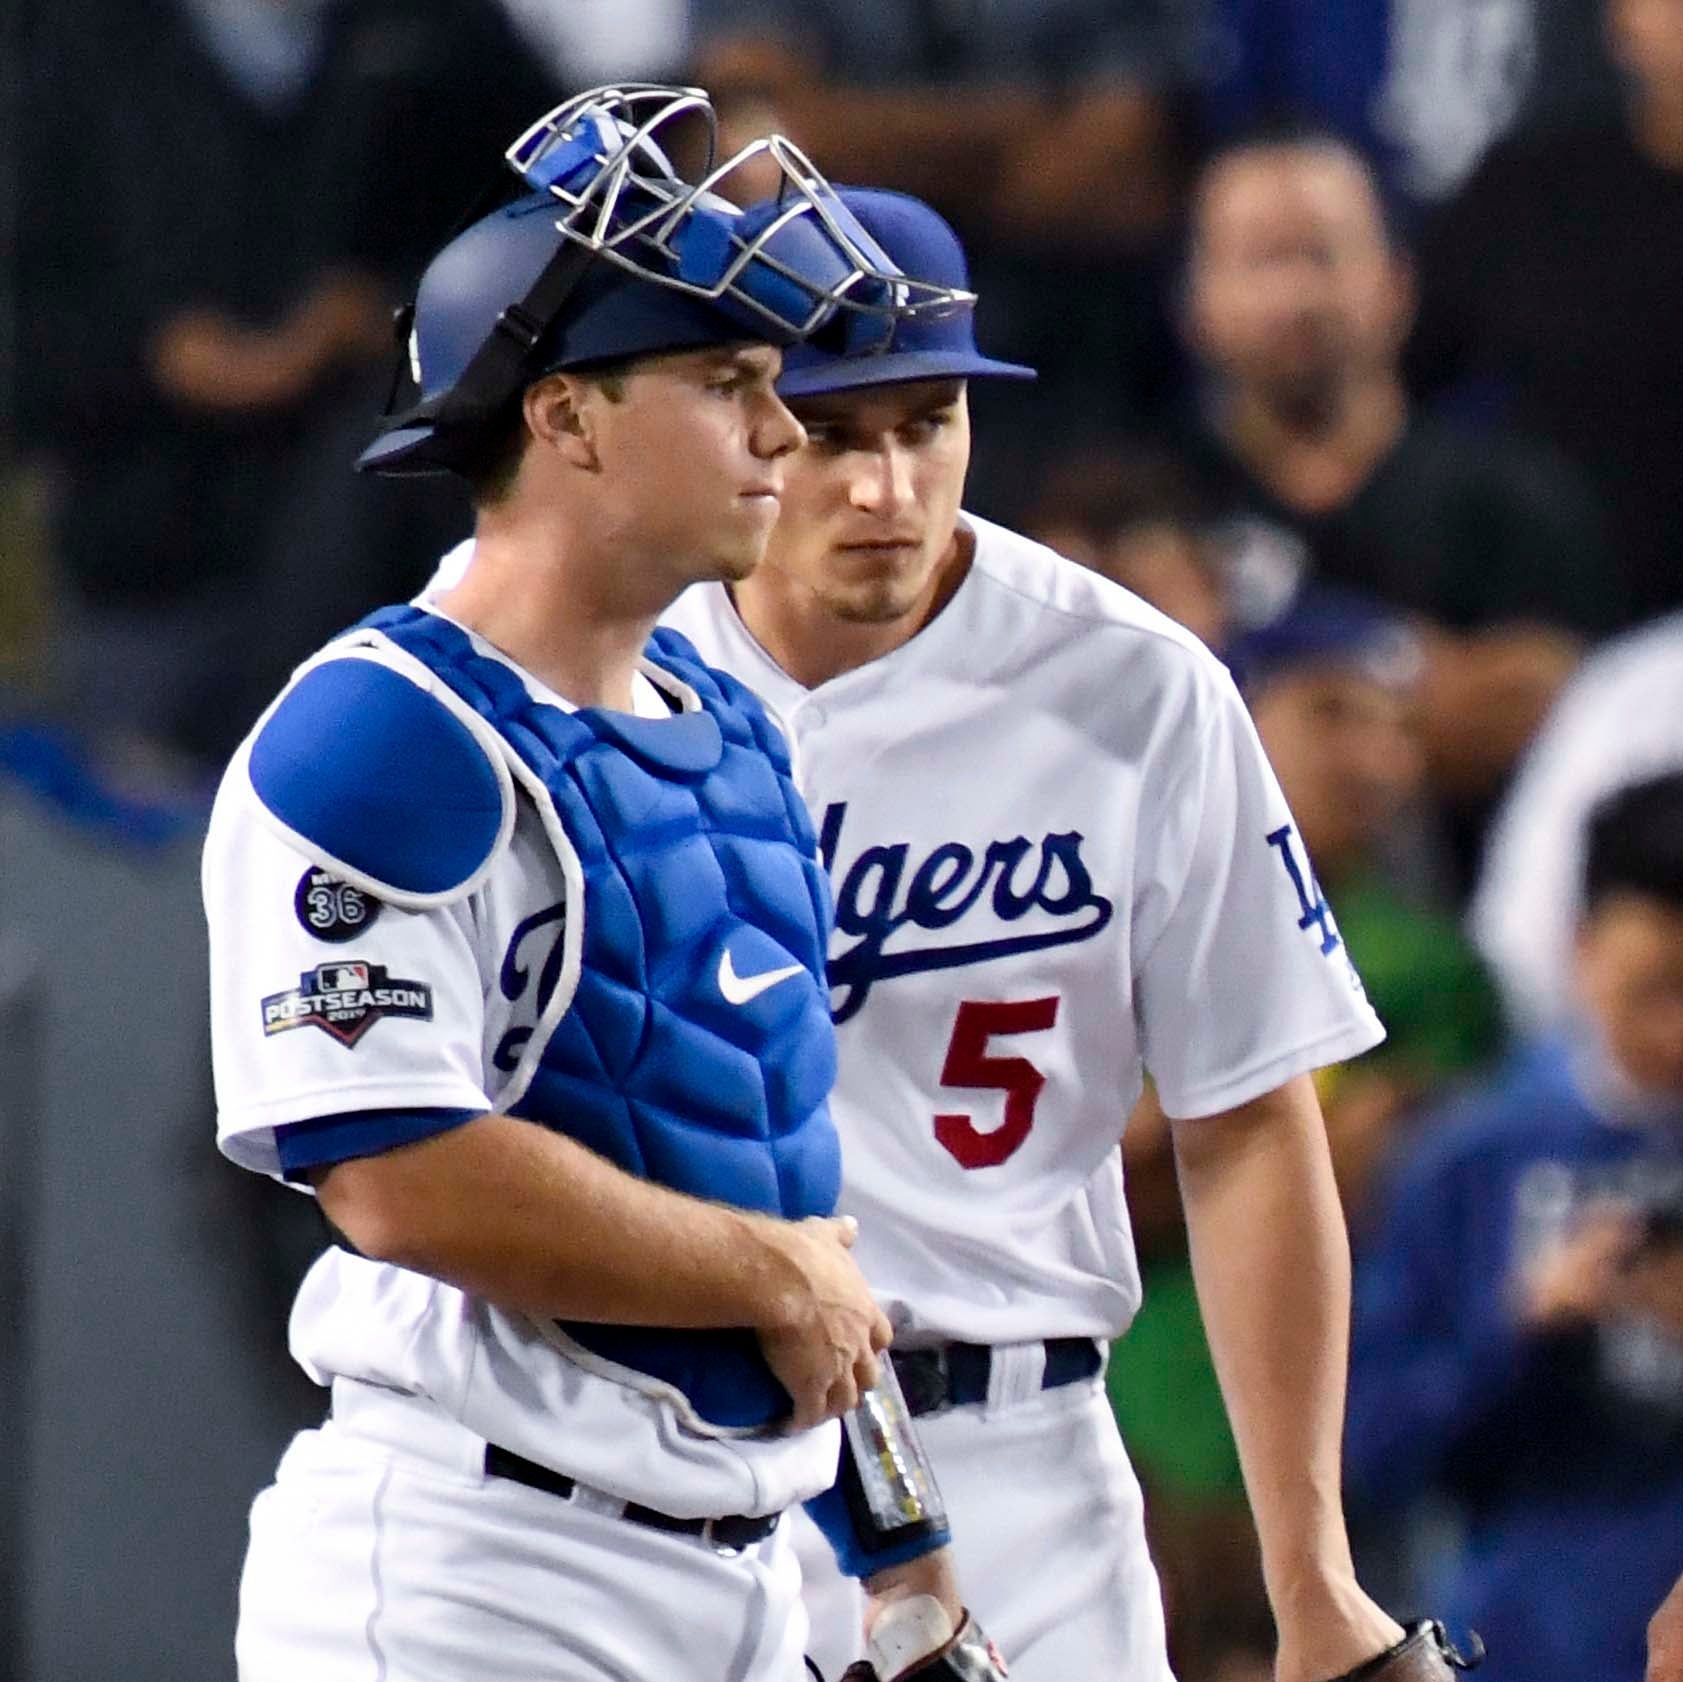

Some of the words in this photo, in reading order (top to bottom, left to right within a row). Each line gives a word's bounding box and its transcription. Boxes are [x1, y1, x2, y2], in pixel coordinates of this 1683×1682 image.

[307, 883, 366, 928] 36
[265, 989, 426, 1023] POSTSEASON
[933, 995, 1060, 1170] 5
